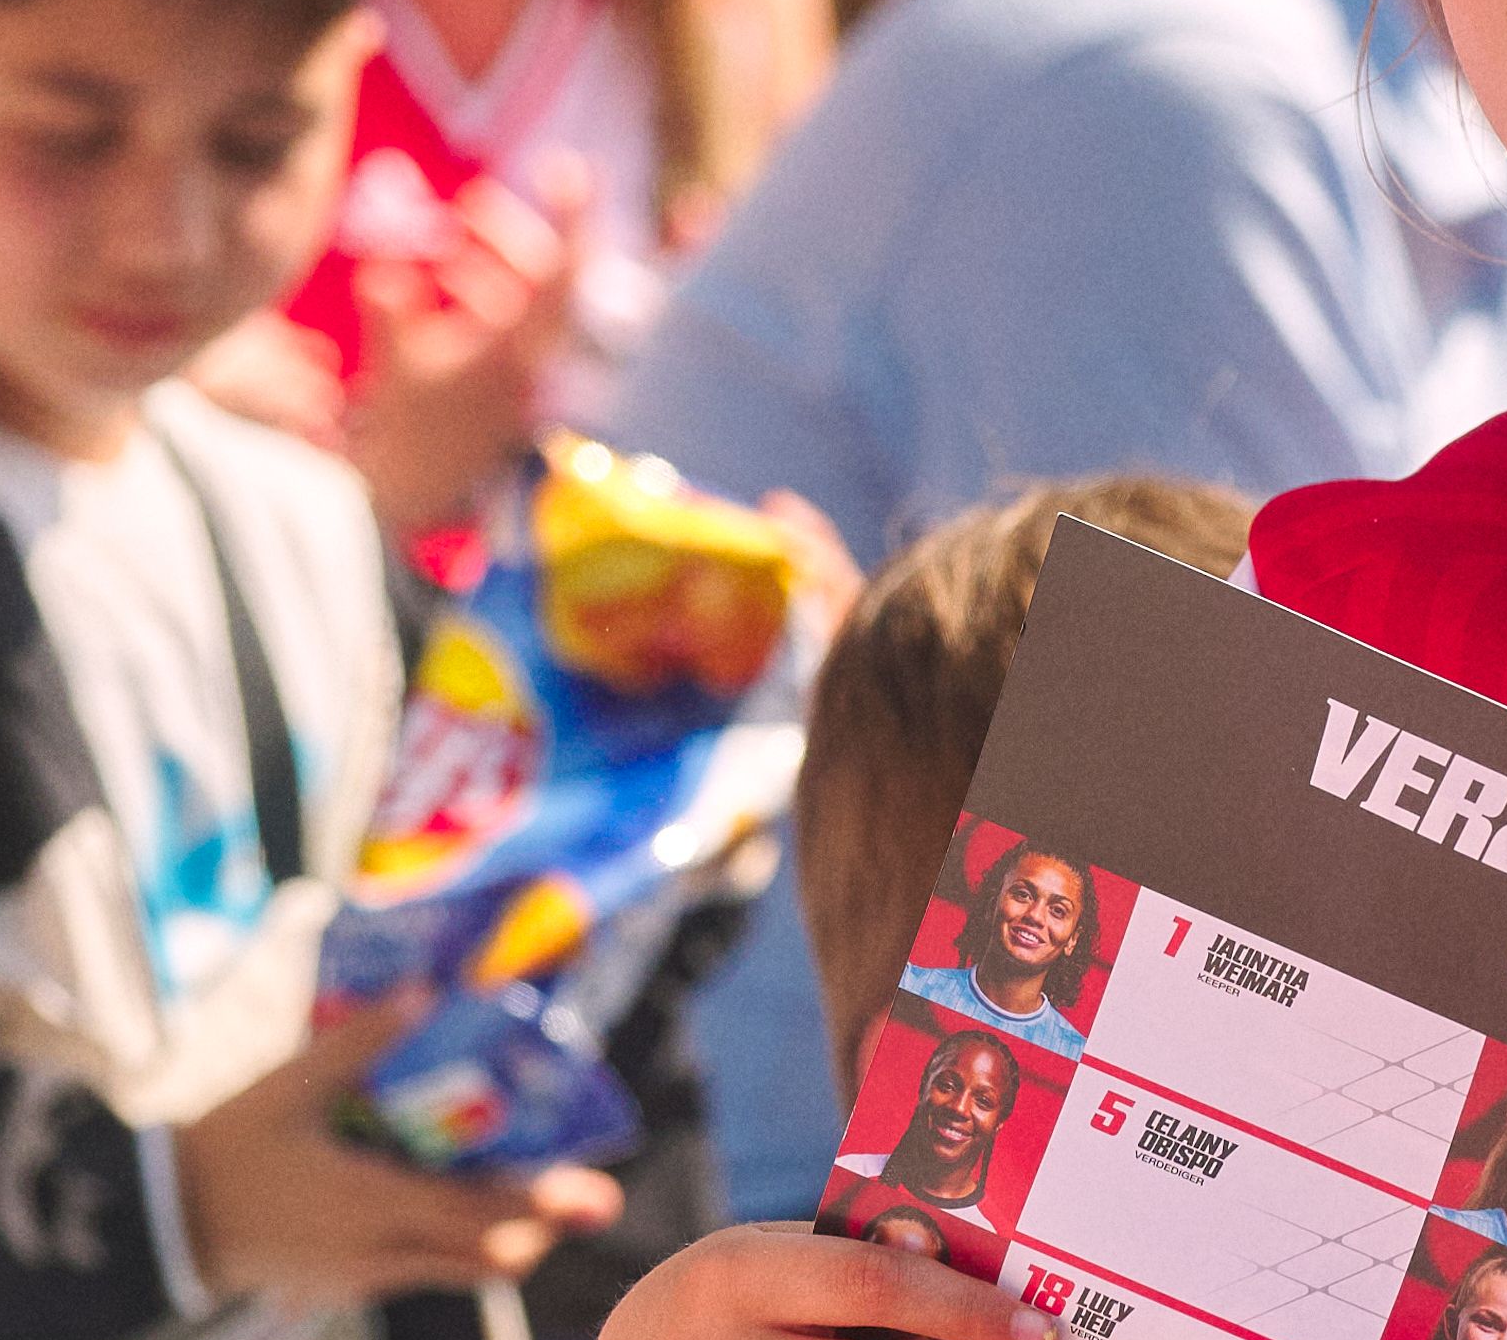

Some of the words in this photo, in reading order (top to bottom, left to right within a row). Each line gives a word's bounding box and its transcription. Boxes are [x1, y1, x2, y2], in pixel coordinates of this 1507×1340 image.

[1164, 916, 1192, 957] 1
[1197, 973, 1240, 997] KEEPER
[1203, 952, 1298, 1008] WEIMAR
[1207, 934, 1310, 992] JACINTHA
[1090, 1090, 1136, 1136] 5
[1145, 1110, 1239, 1160] CELAINY
[1135, 1150, 1205, 1186] VERDEDIGER
[1137, 1129, 1224, 1179] OBISPO
[1020, 1264, 1075, 1317] 18
[1076, 1287, 1135, 1322] LUCY
